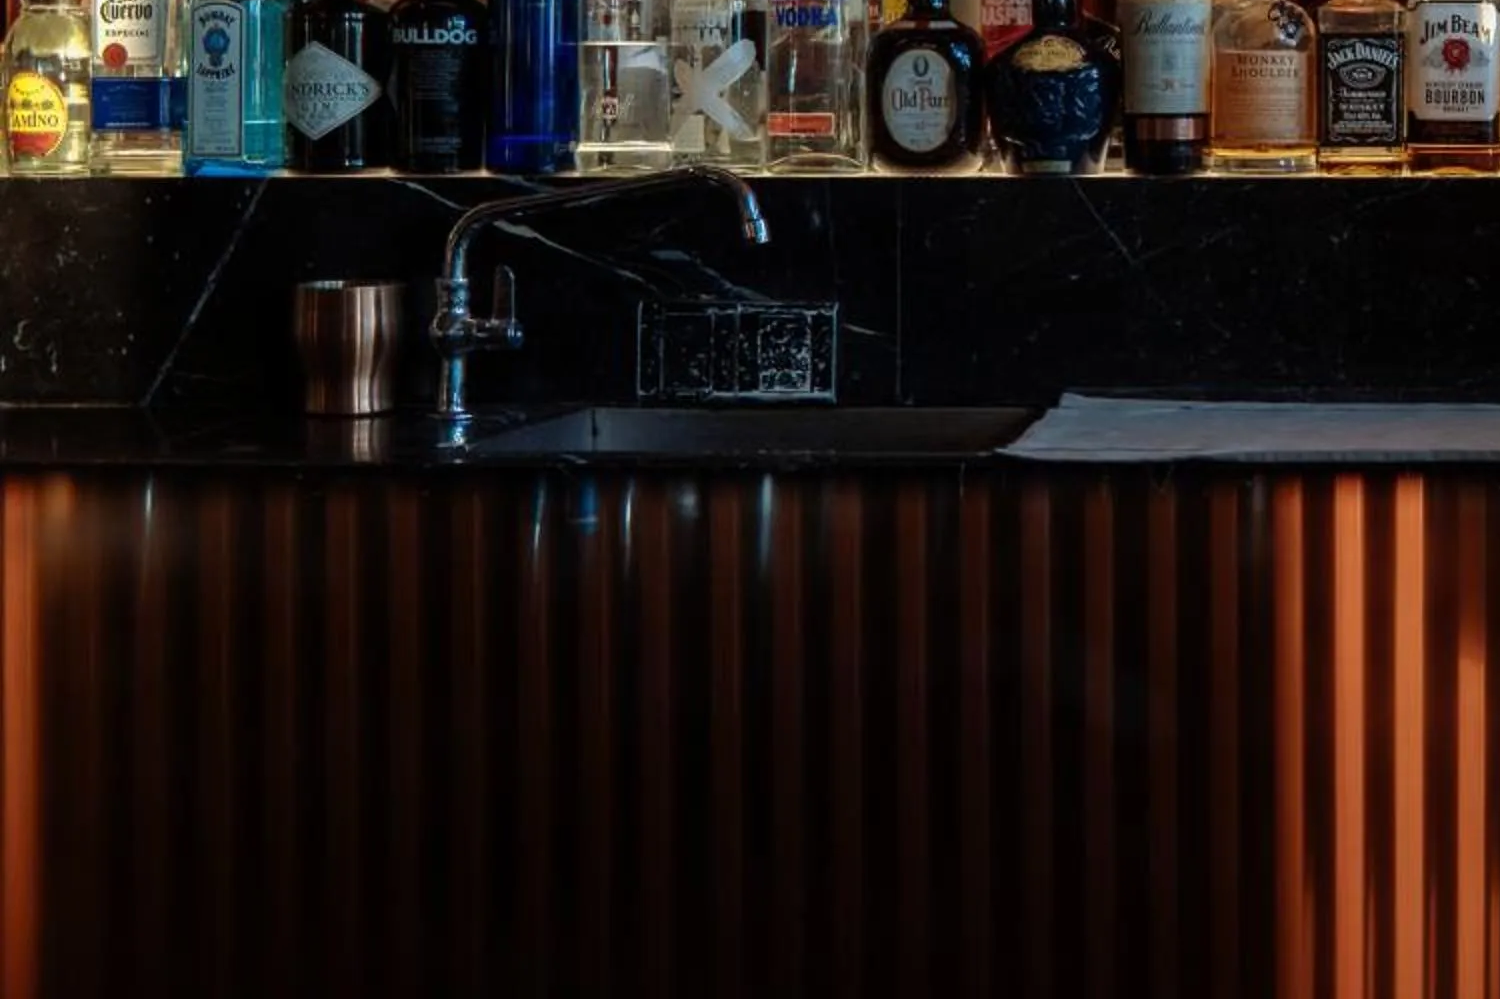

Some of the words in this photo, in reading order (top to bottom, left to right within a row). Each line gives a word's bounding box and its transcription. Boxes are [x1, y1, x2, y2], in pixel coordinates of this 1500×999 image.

[100, 0, 153, 23] Cuervo
[776, 7, 837, 26] VODKA
[392, 29, 478, 45] BULLDOG
[1420, 19, 1449, 45] JIM
[1425, 89, 1485, 105] BOURBON
